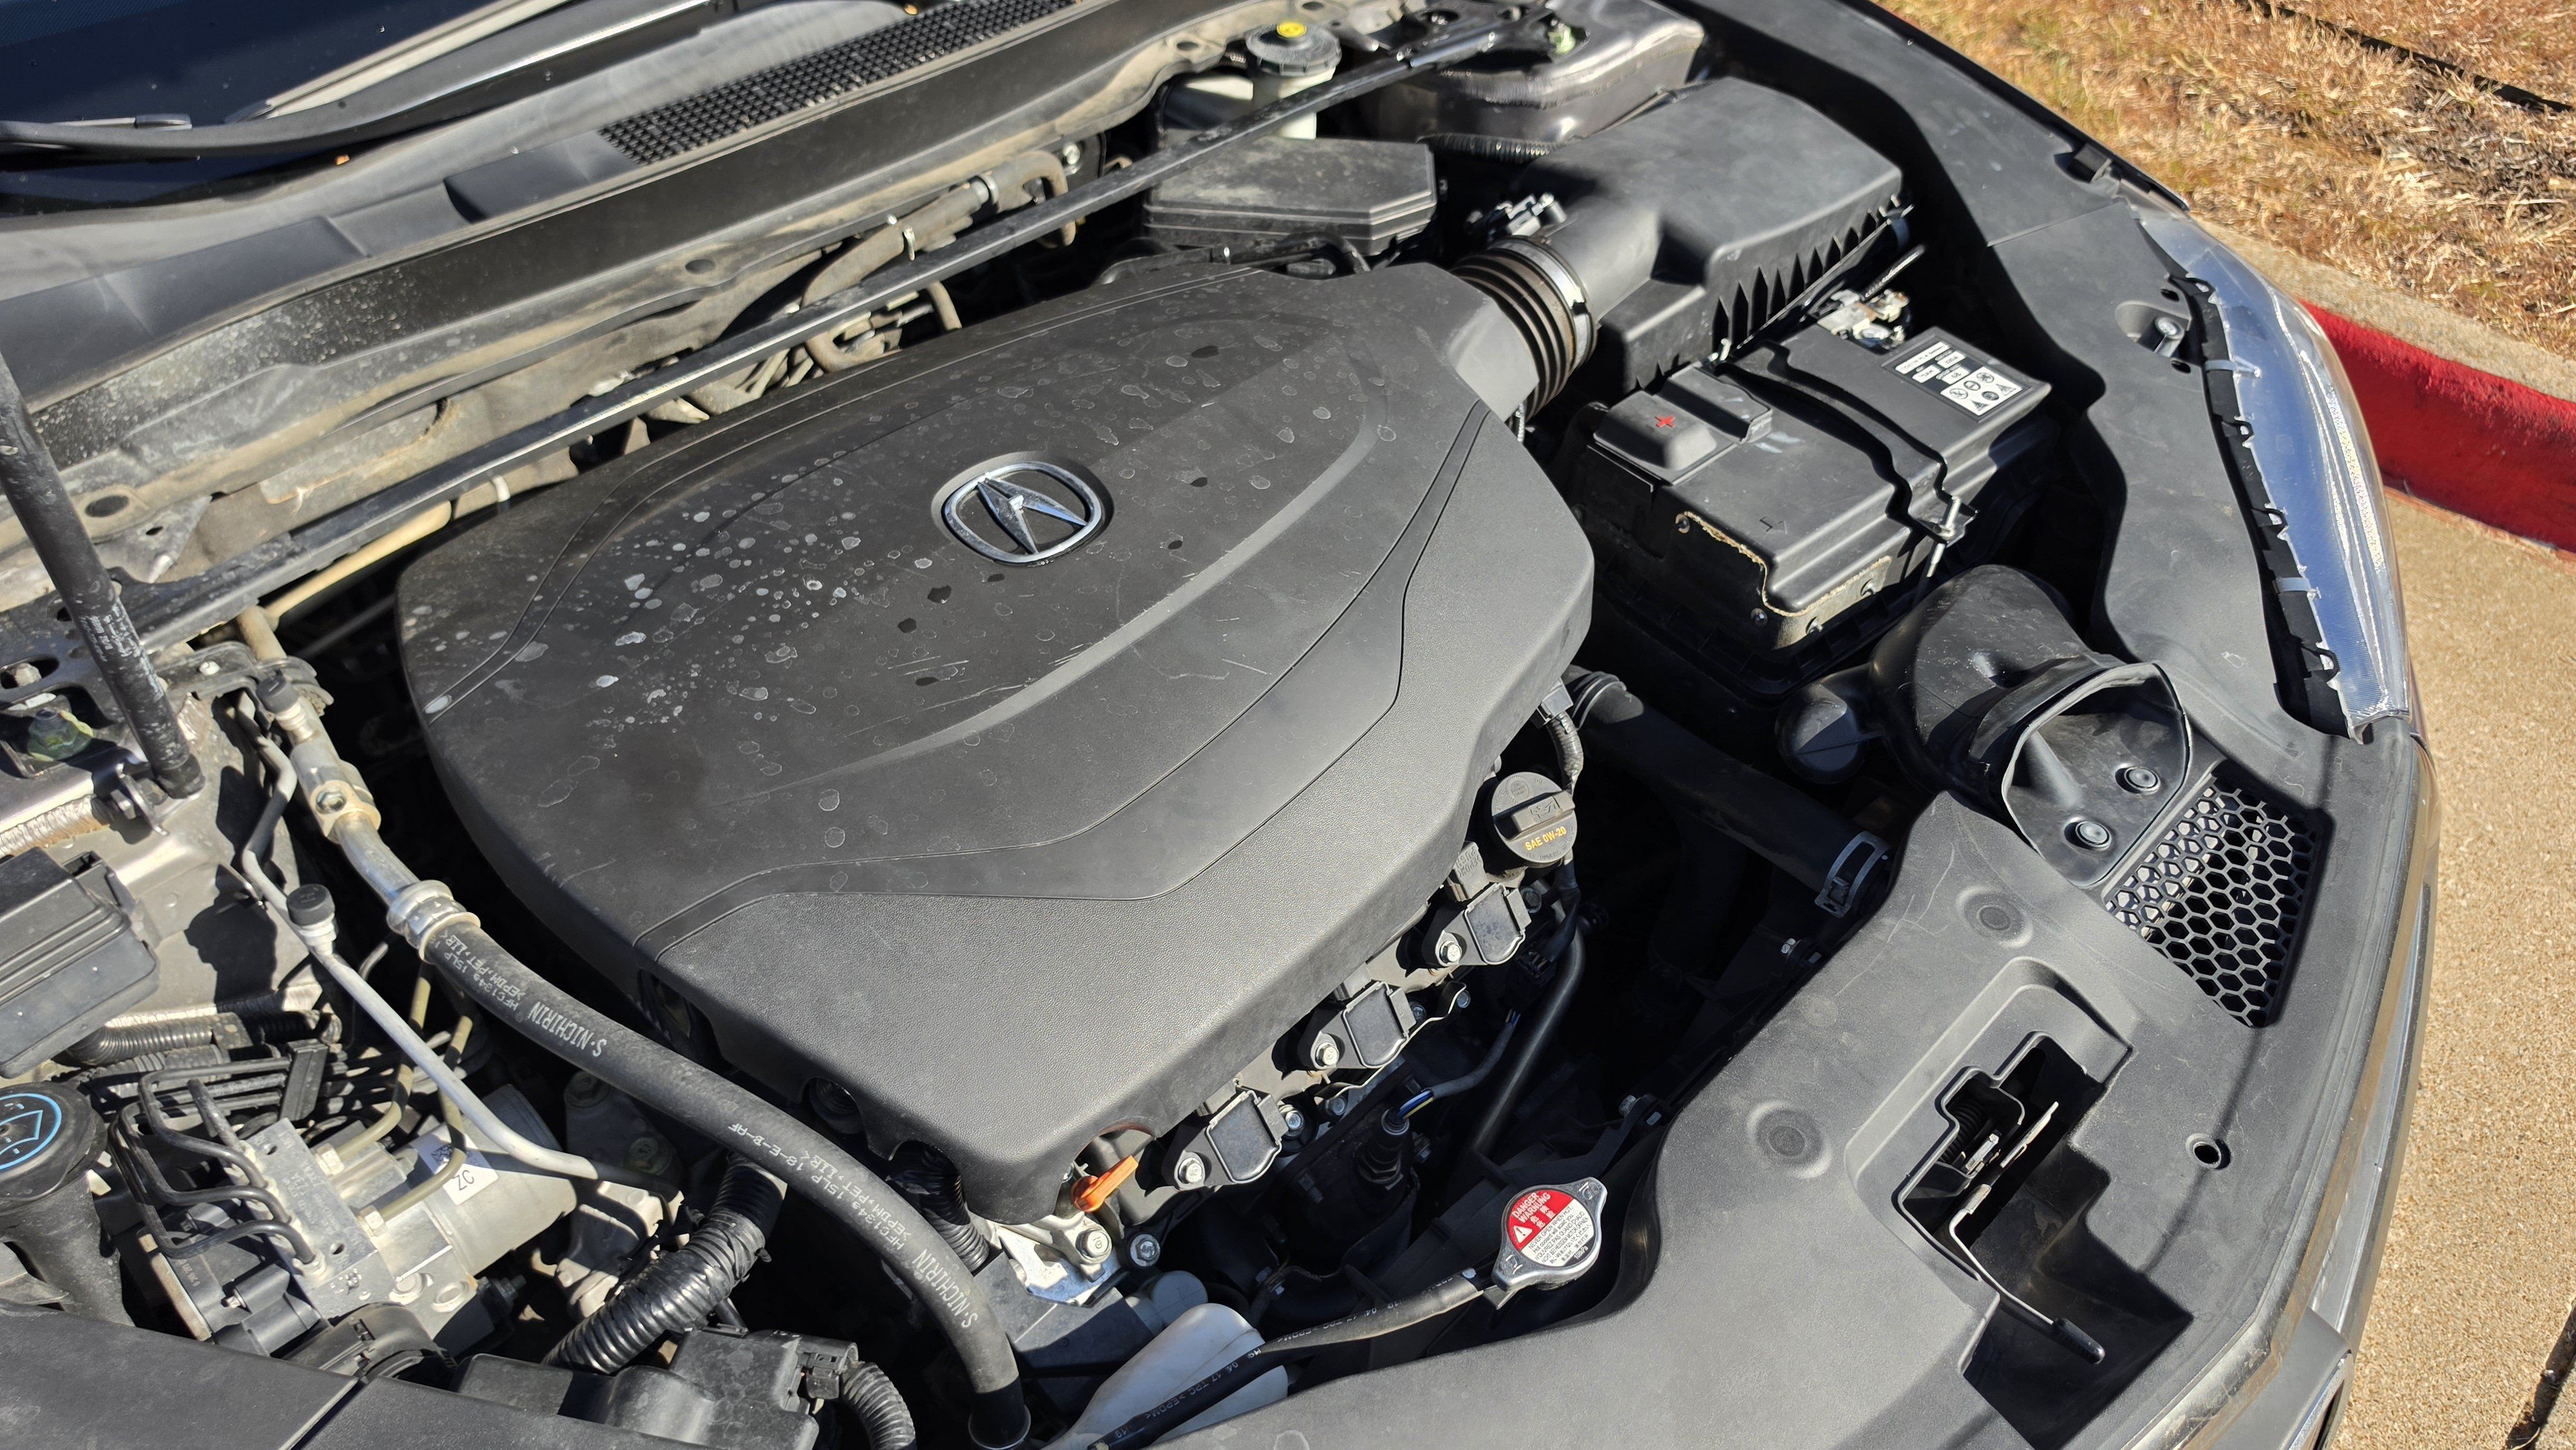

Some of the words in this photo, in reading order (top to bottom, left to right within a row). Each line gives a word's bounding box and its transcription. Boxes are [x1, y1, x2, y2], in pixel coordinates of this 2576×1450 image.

[1524, 836, 1543, 851] SAE
[1542, 825, 1567, 842] 0W-20
[443, 950, 468, 973] 15LP
[810, 1171, 845, 1200] 15LP
[1511, 1191, 1539, 1218] DANGER
[1519, 1192, 1551, 1223] WARNUNG
[850, 1200, 905, 1250] HFC134a
[1528, 1234, 1542, 1248] NEVER
[1540, 1224, 1554, 1237] OPEN
[1552, 1214, 1564, 1226] WHEN
[1551, 1234, 1560, 1243] PAS
[1187, 1379, 1209, 1395] TPC
[1209, 1371, 1222, 1381] 17
